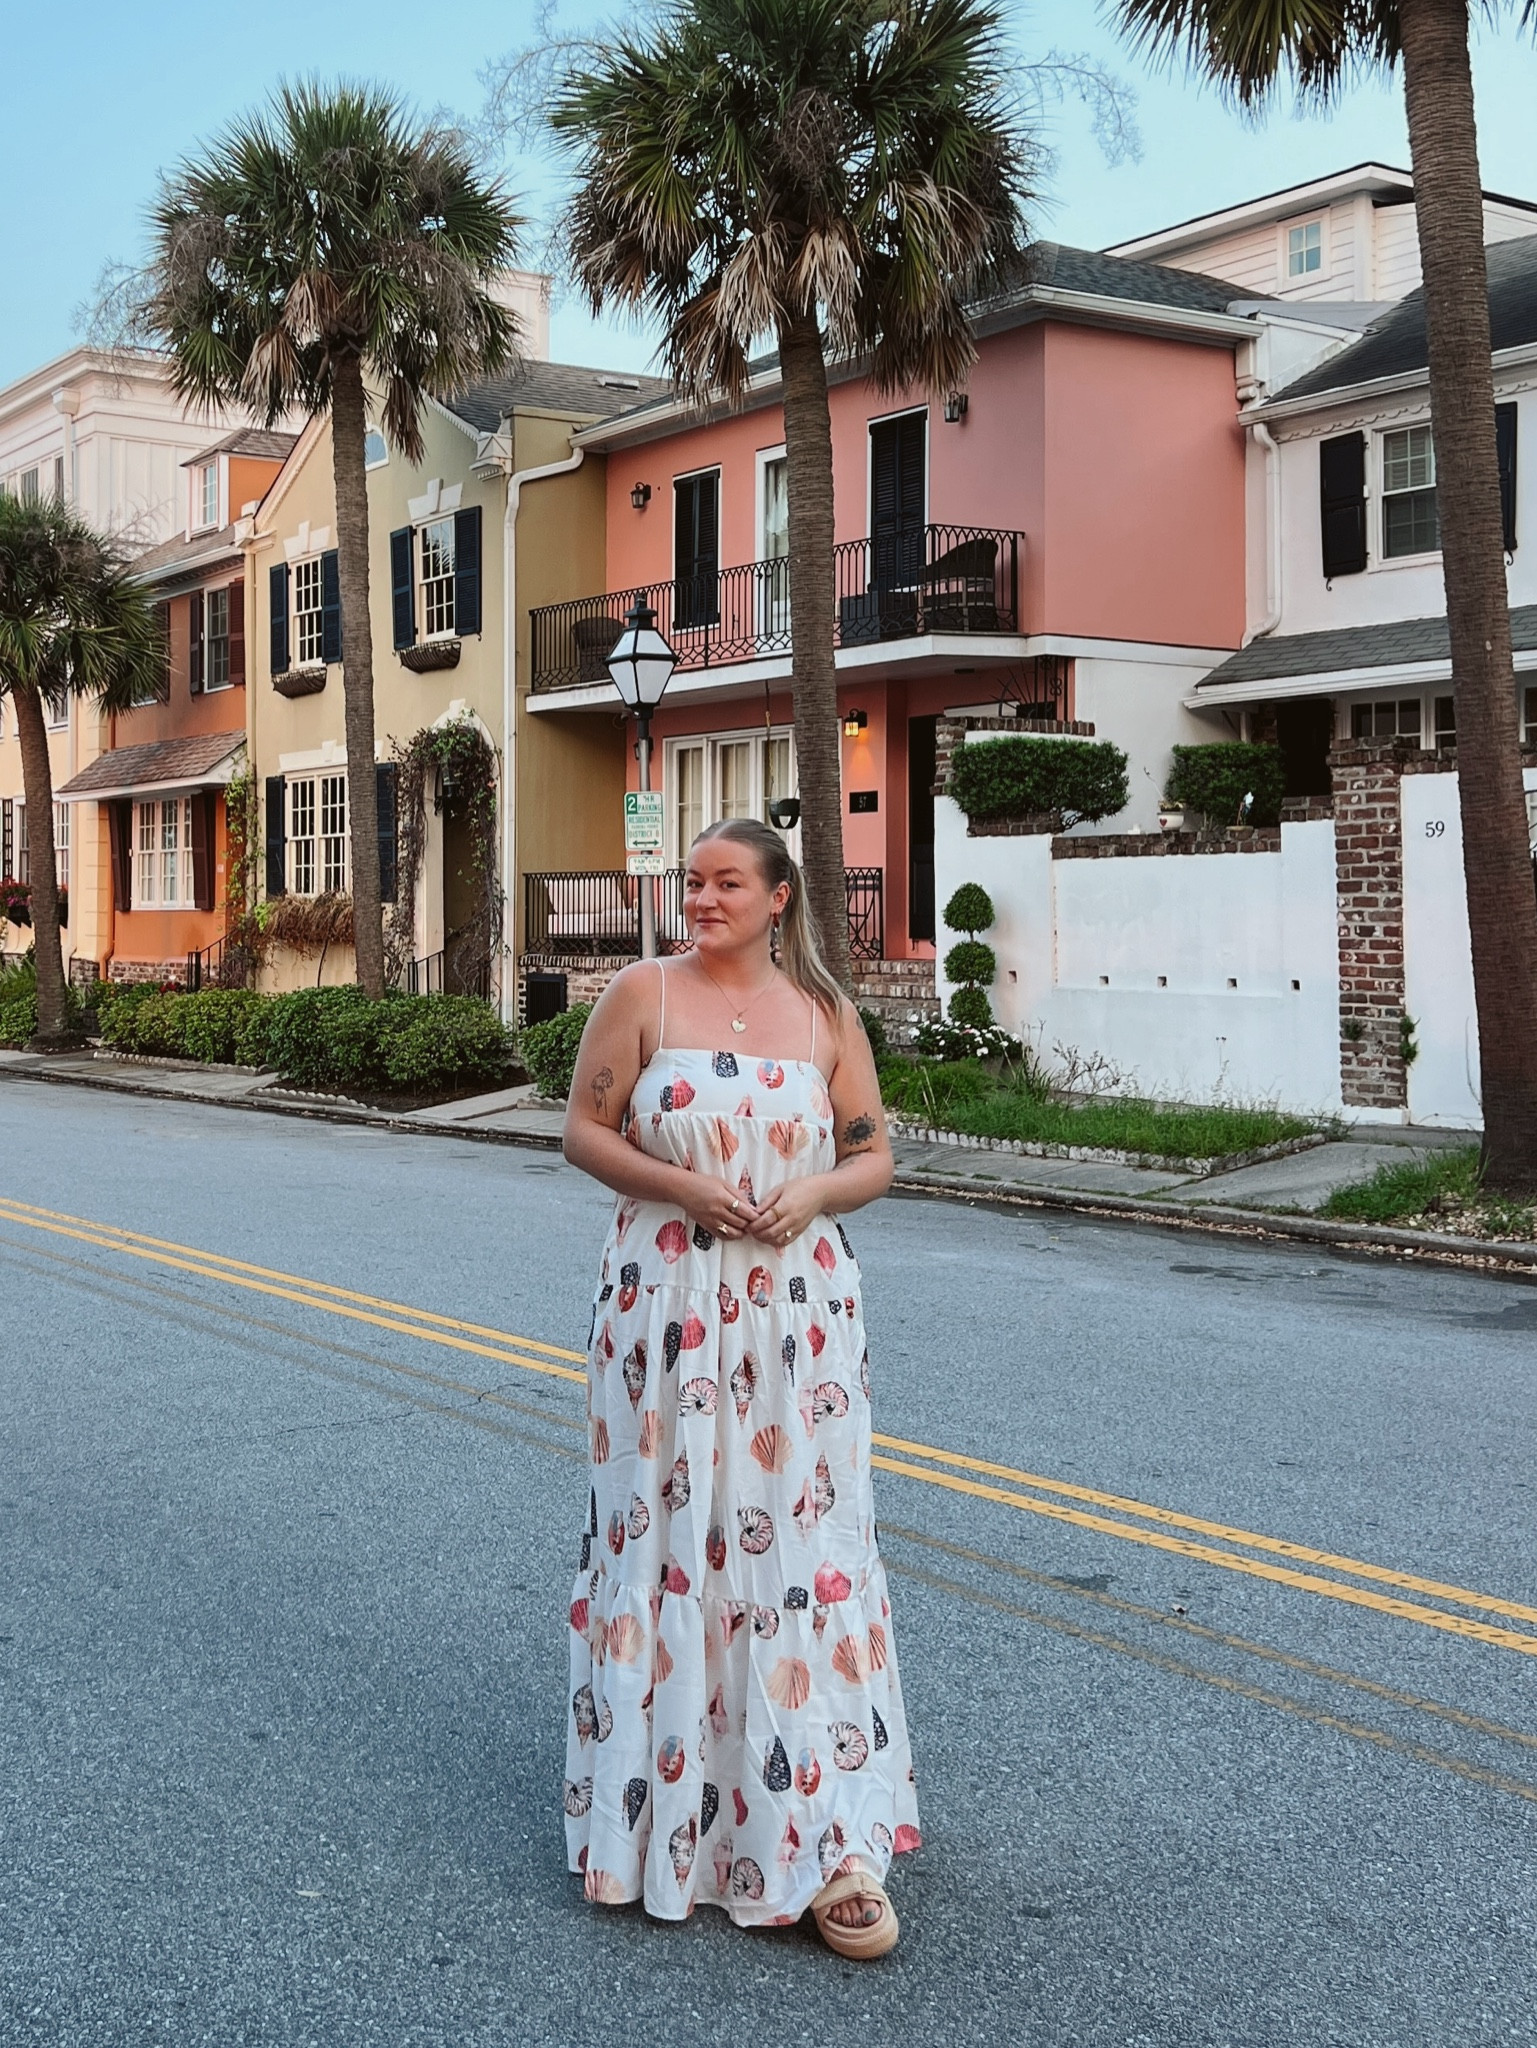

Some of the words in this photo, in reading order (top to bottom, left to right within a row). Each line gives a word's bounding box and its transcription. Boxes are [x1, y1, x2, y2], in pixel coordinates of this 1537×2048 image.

[628, 797, 637, 811] 2
[628, 815, 660, 823] RESIDENTIAL
[629, 830, 653, 838] DISTRICT
[1425, 820, 1445, 838] 59
